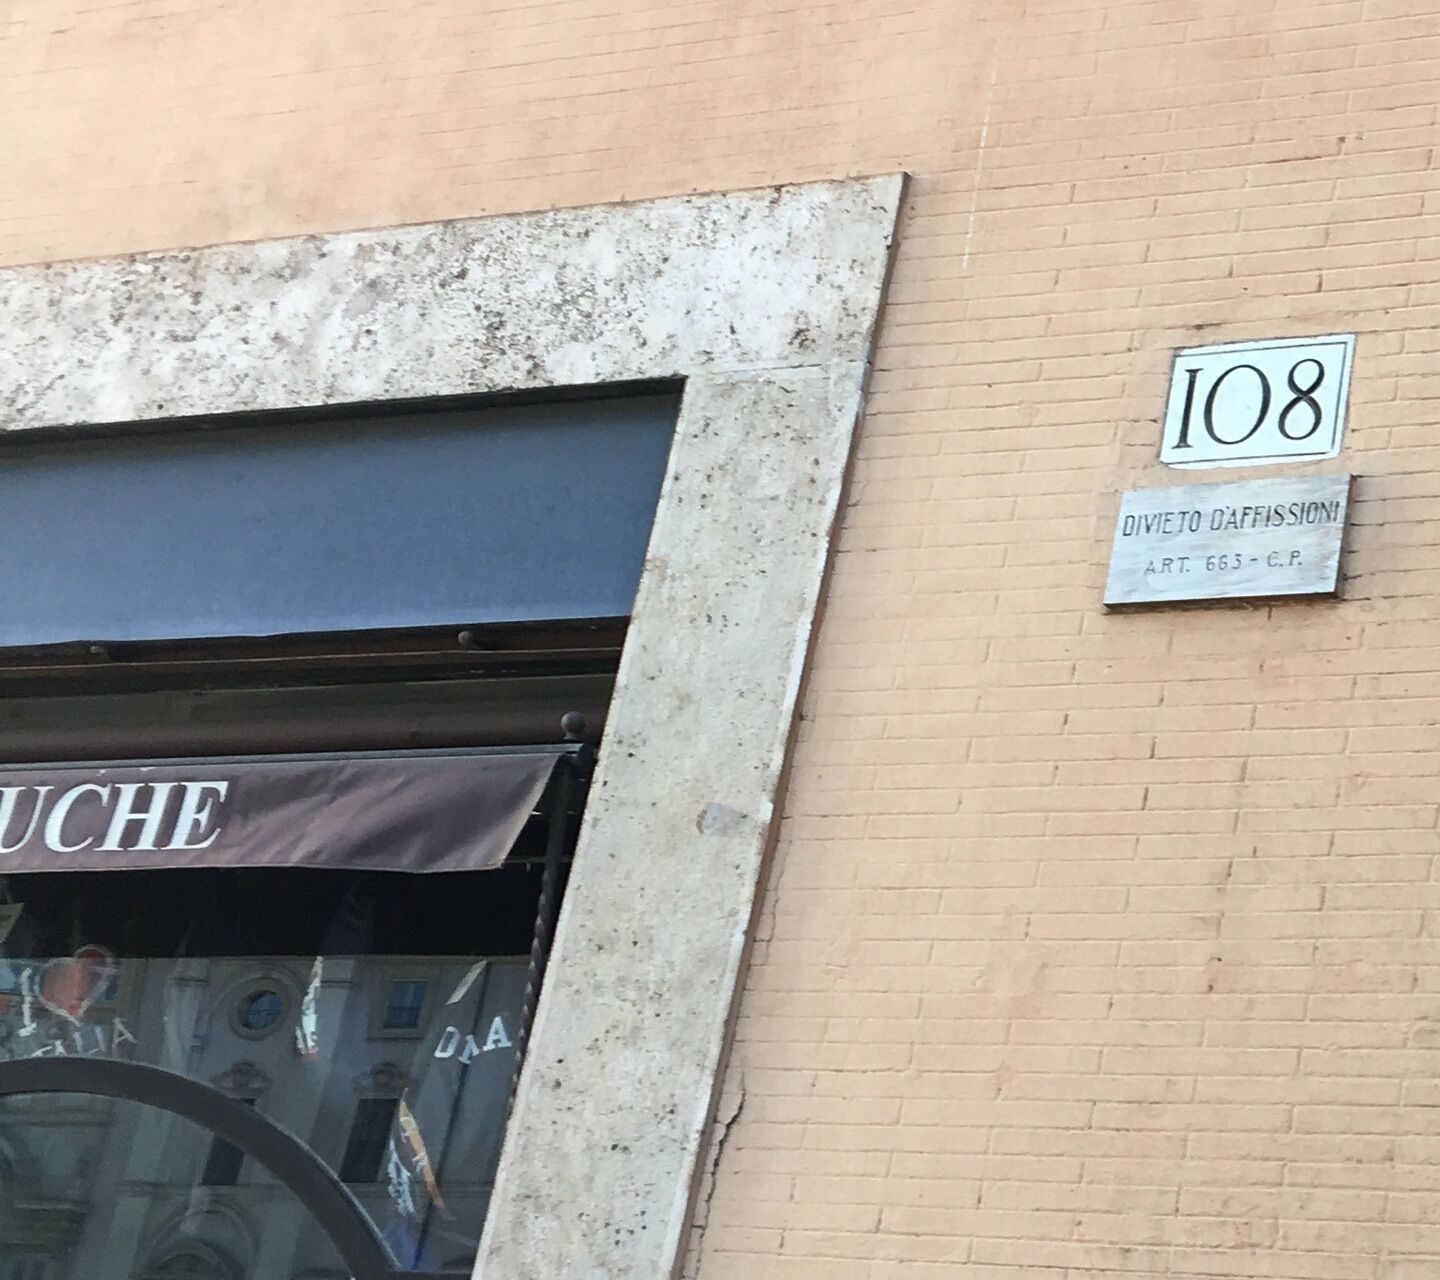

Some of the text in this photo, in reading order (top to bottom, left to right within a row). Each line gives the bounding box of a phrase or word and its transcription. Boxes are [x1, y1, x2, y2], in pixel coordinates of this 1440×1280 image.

[1170, 358, 1326, 450] 108
[1121, 509, 1202, 537] DIVIETO
[1142, 556, 1191, 576] ART.
[0, 780, 229, 854] UCHE
